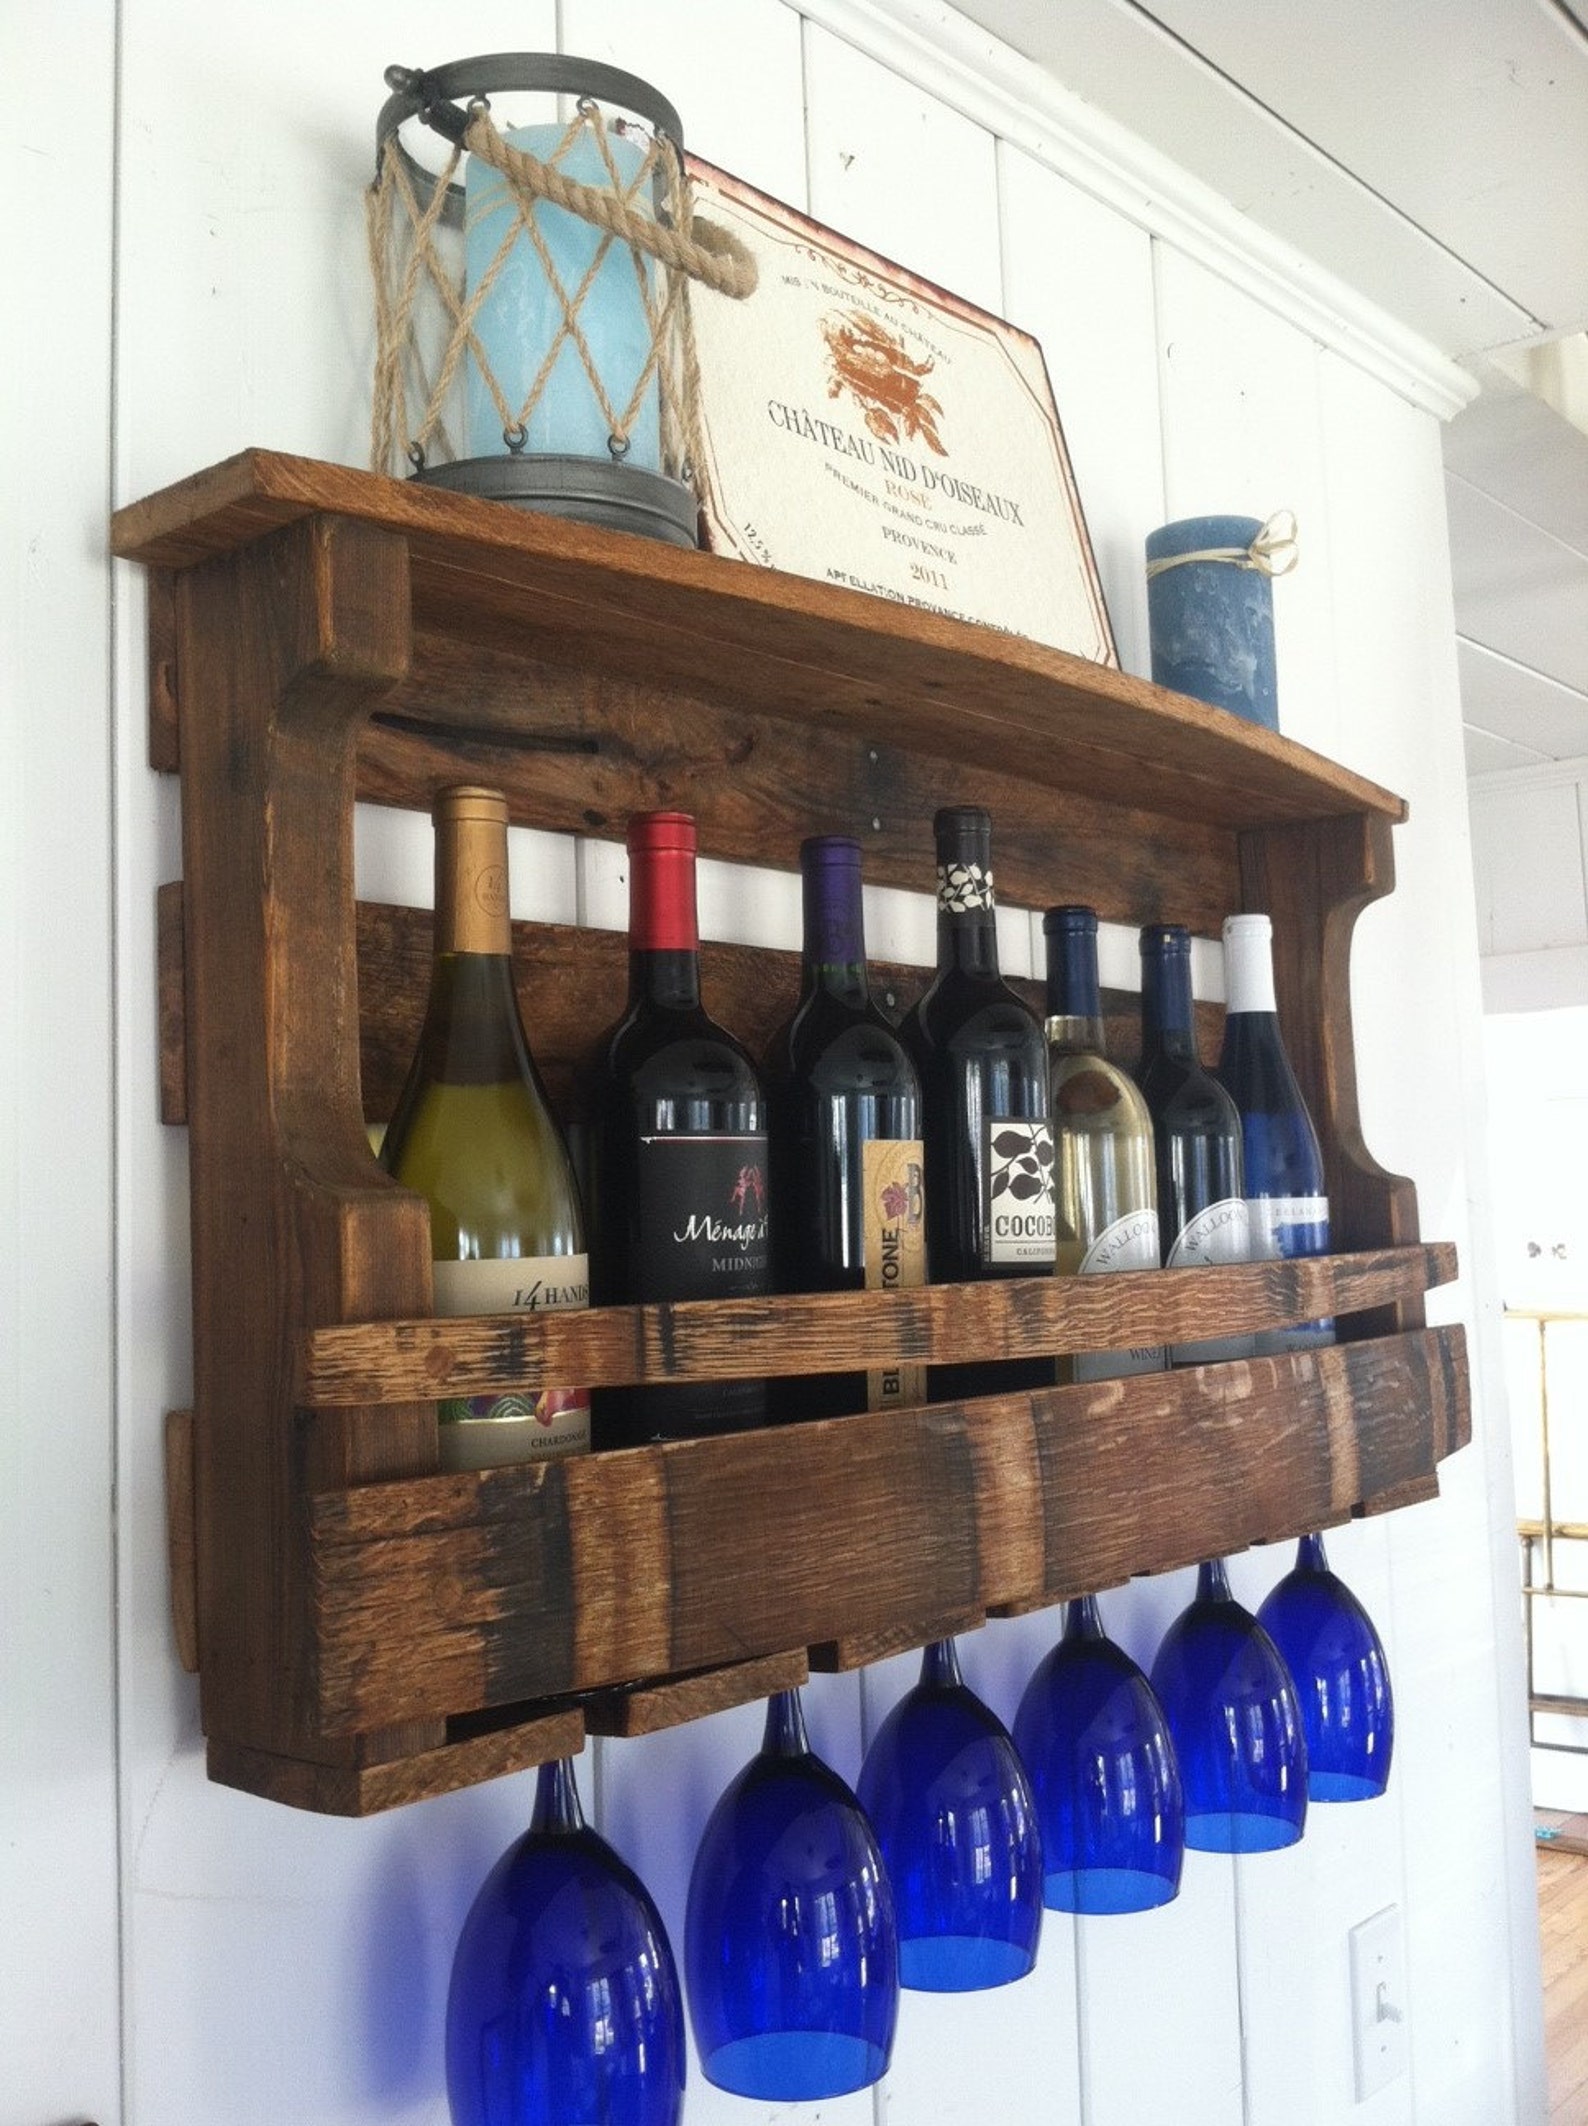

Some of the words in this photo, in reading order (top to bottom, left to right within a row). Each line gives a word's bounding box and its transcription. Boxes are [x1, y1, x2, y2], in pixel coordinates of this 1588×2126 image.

[767, 399, 876, 465] CHÂTEAU
[880, 446, 917, 483] NID
[824, 462, 880, 506] PREMIER
[882, 501, 923, 526] GRAND
[924, 518, 947, 534] CRU
[881, 525, 958, 565] PROVENCE
[909, 561, 949, 591] 2011
[673, 1213, 756, 1251] Ménage
[995, 1214, 1057, 1237] COCOB
[512, 1280, 542, 1311] 14
